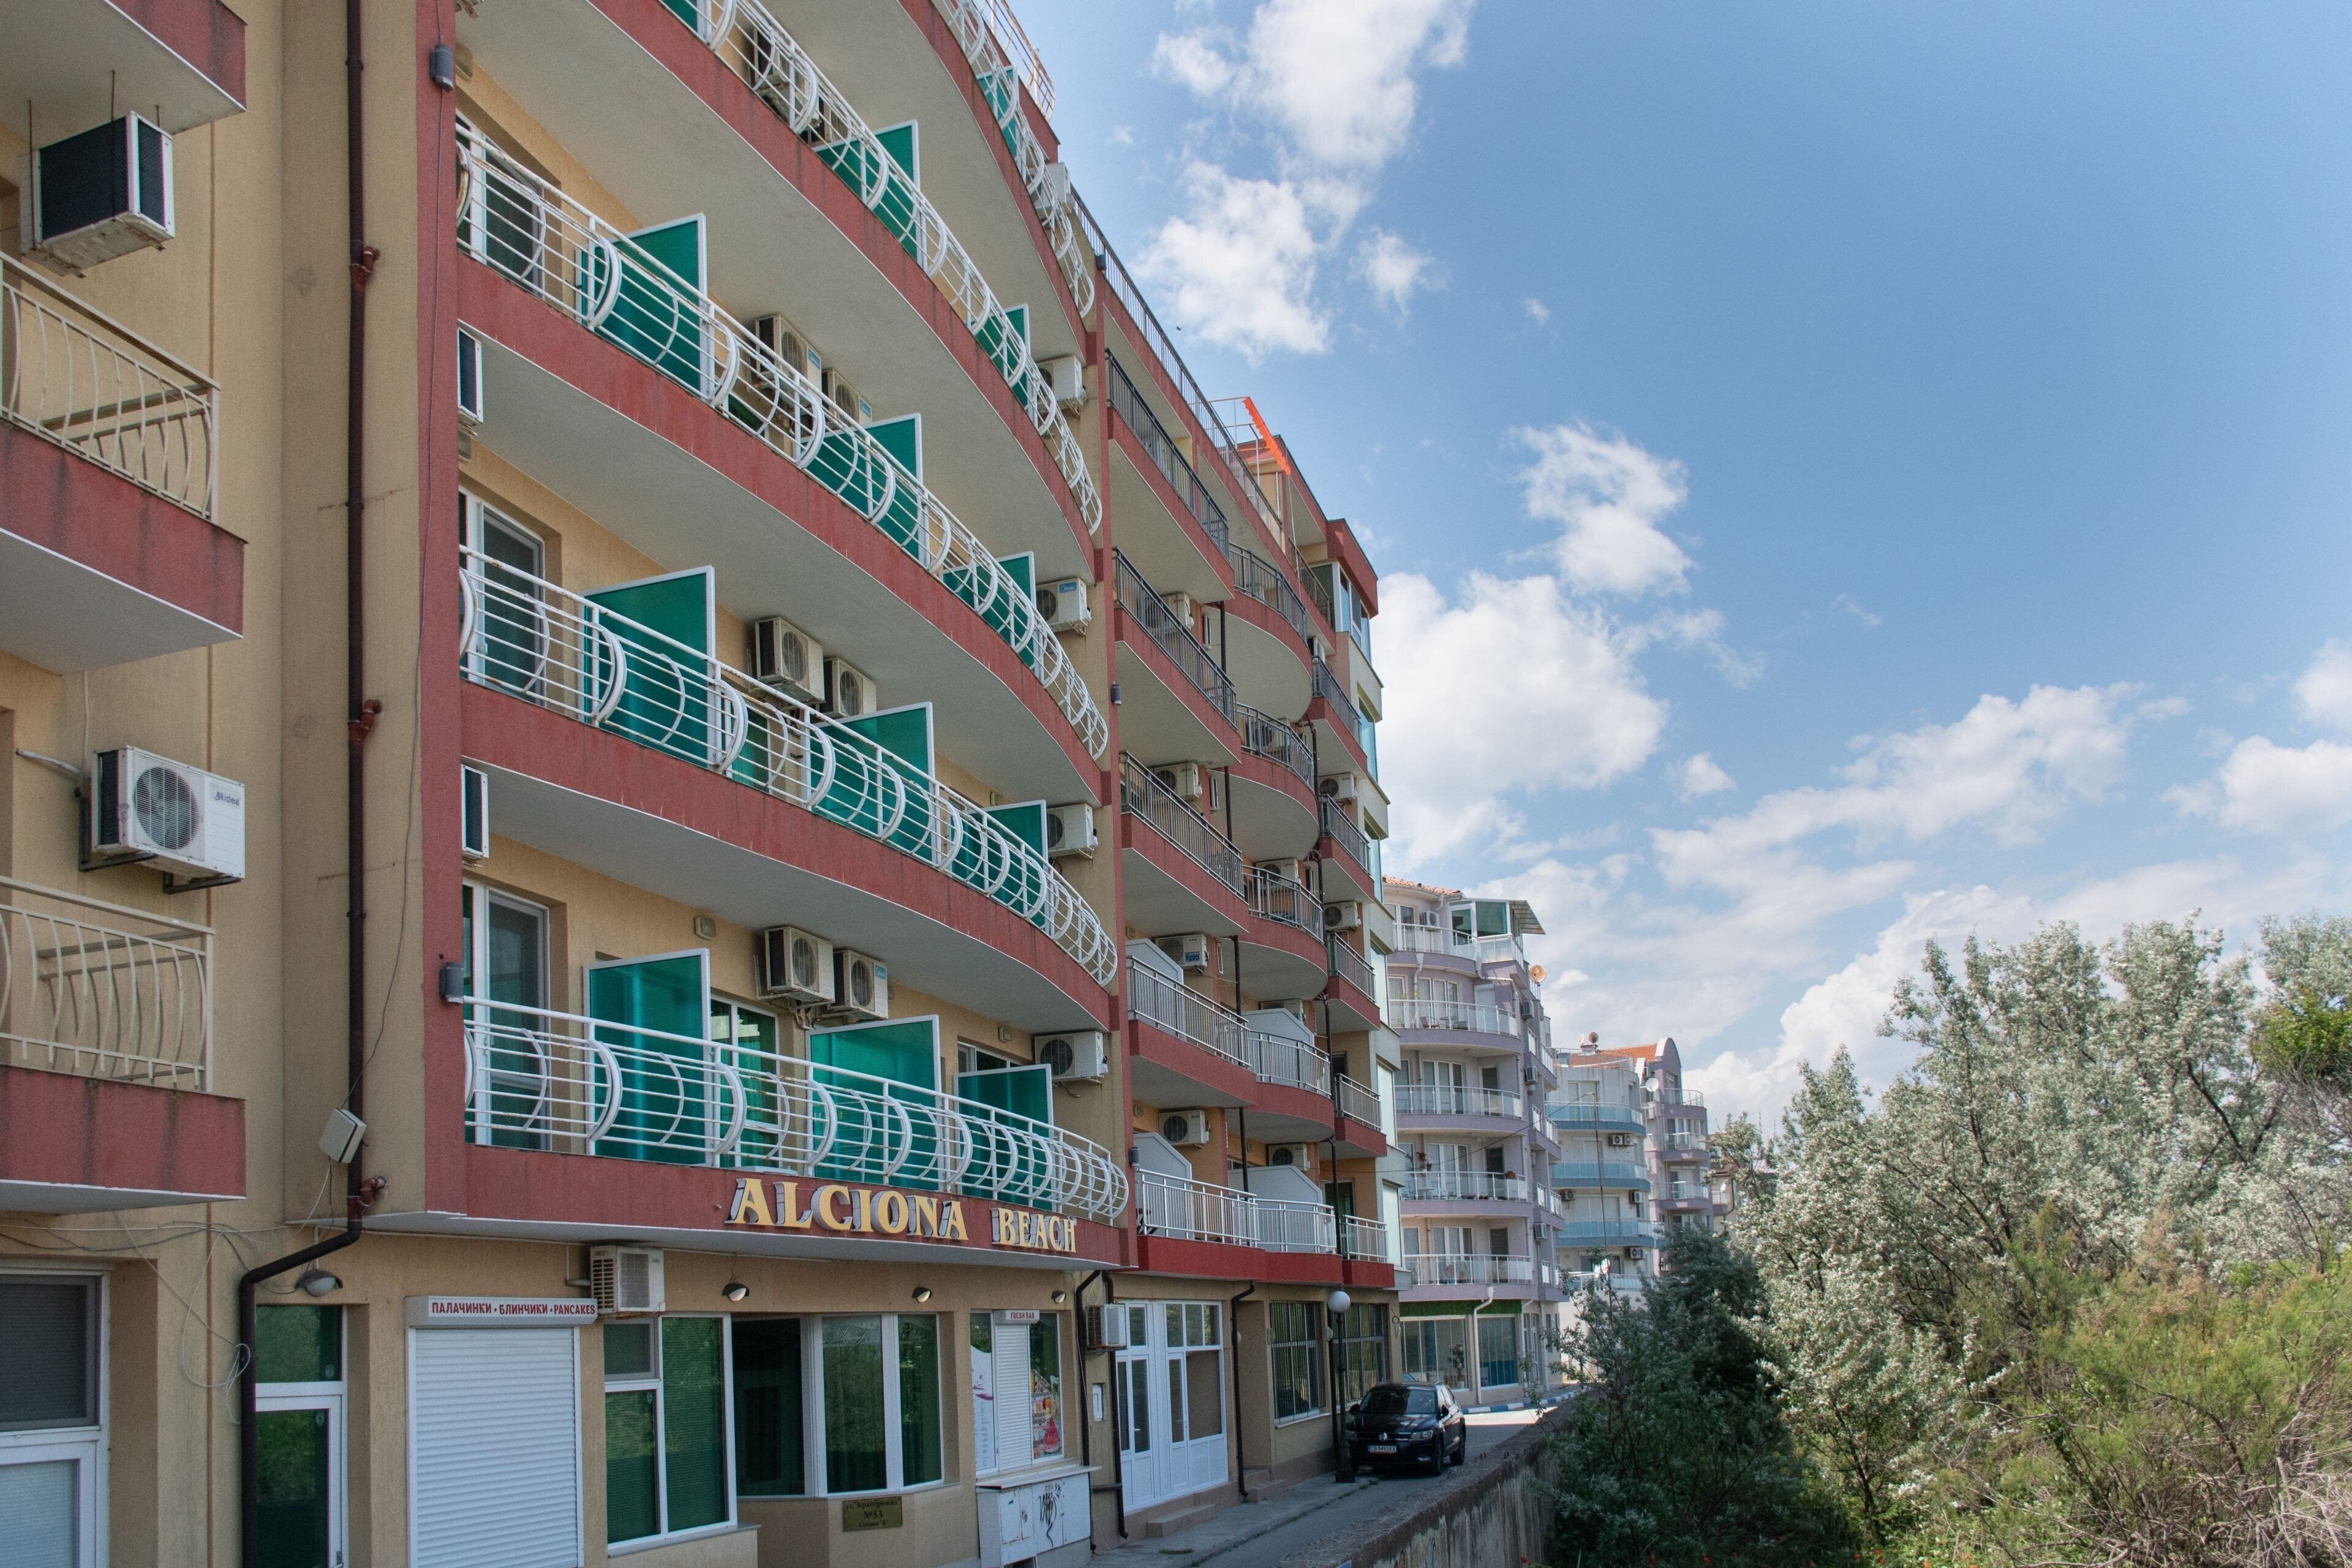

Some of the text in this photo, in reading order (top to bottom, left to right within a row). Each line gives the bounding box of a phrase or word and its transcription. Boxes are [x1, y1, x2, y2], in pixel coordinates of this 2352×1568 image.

[213, 791, 240, 806] Midea
[725, 1177, 1077, 1253] ALCIONA BEACH
[432, 1302, 596, 1316] ПАЛАЧИНКИ БЛИНЧИКИ PANCAKES
